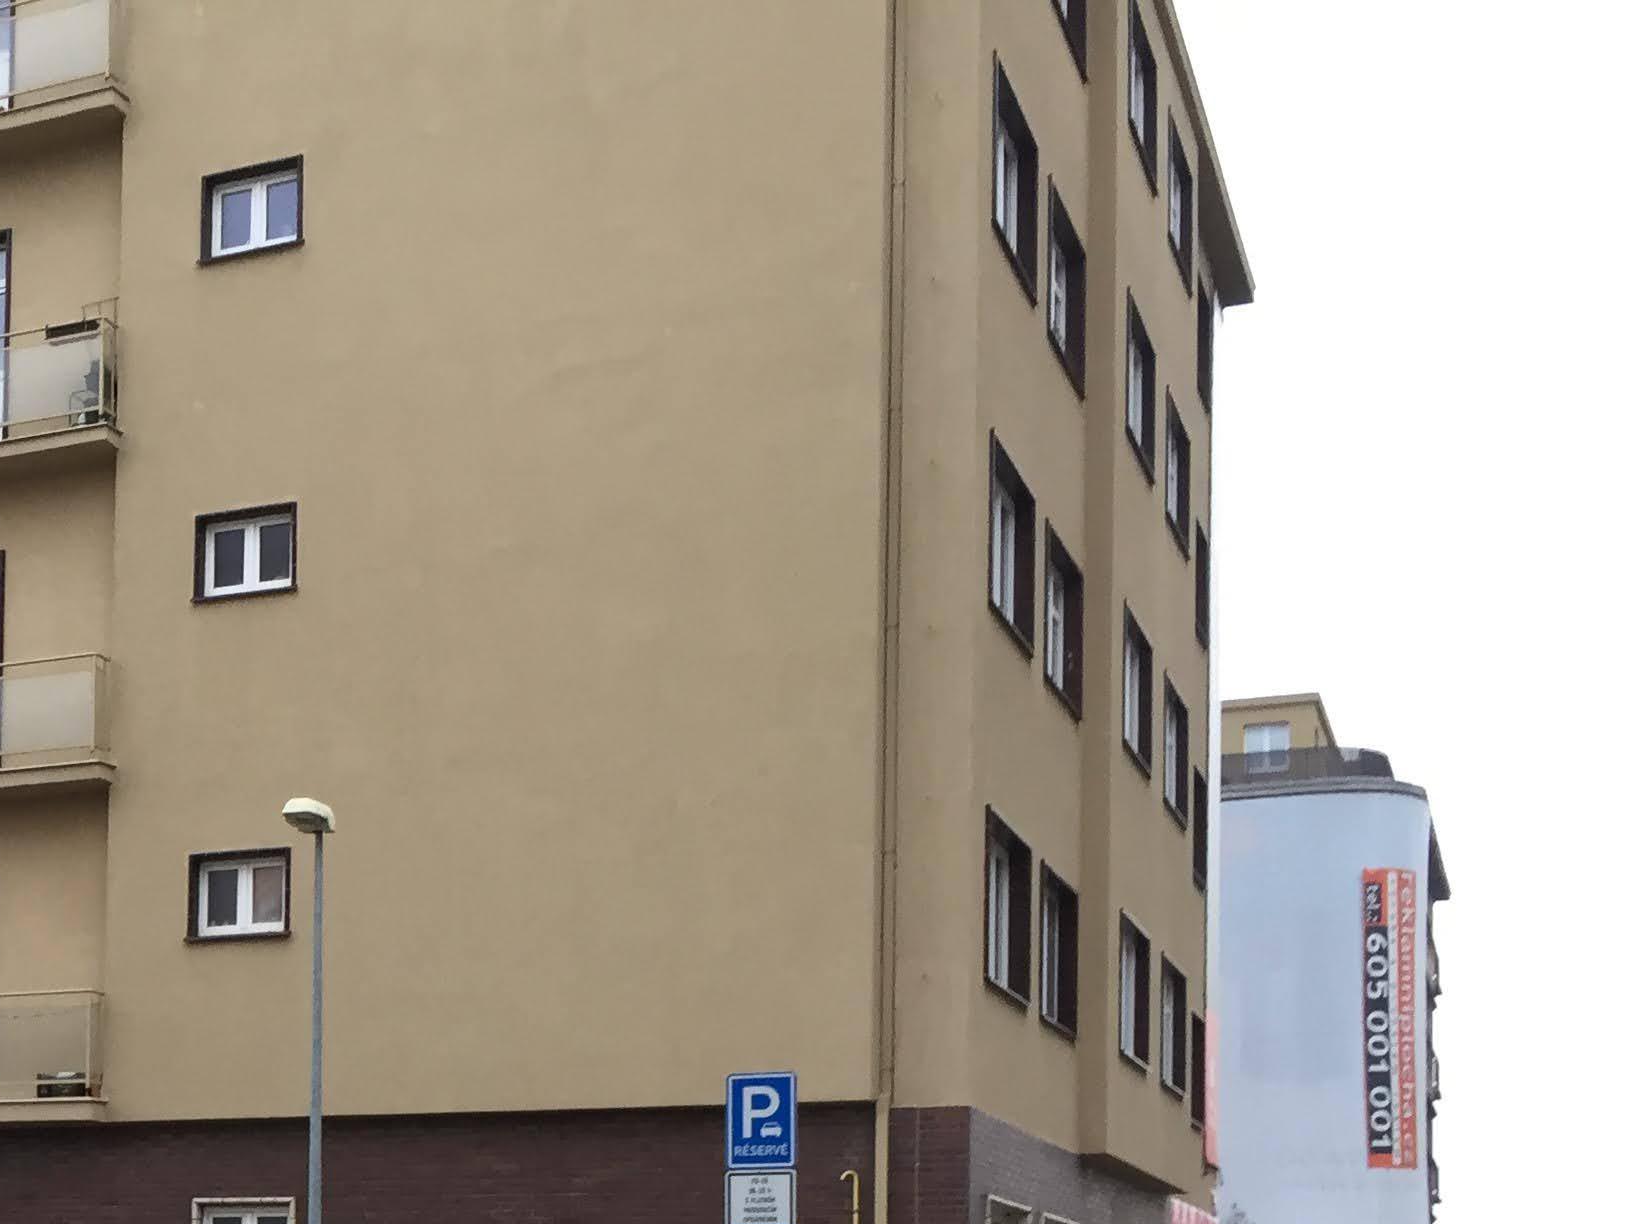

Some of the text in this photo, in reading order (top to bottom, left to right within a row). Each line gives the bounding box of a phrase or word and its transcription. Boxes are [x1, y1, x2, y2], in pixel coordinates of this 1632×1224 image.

[1366, 932, 1388, 1000] 605
[1366, 1010, 1390, 1073] 001
[742, 1085, 780, 1138] P
[1369, 1085, 1393, 1148] 001
